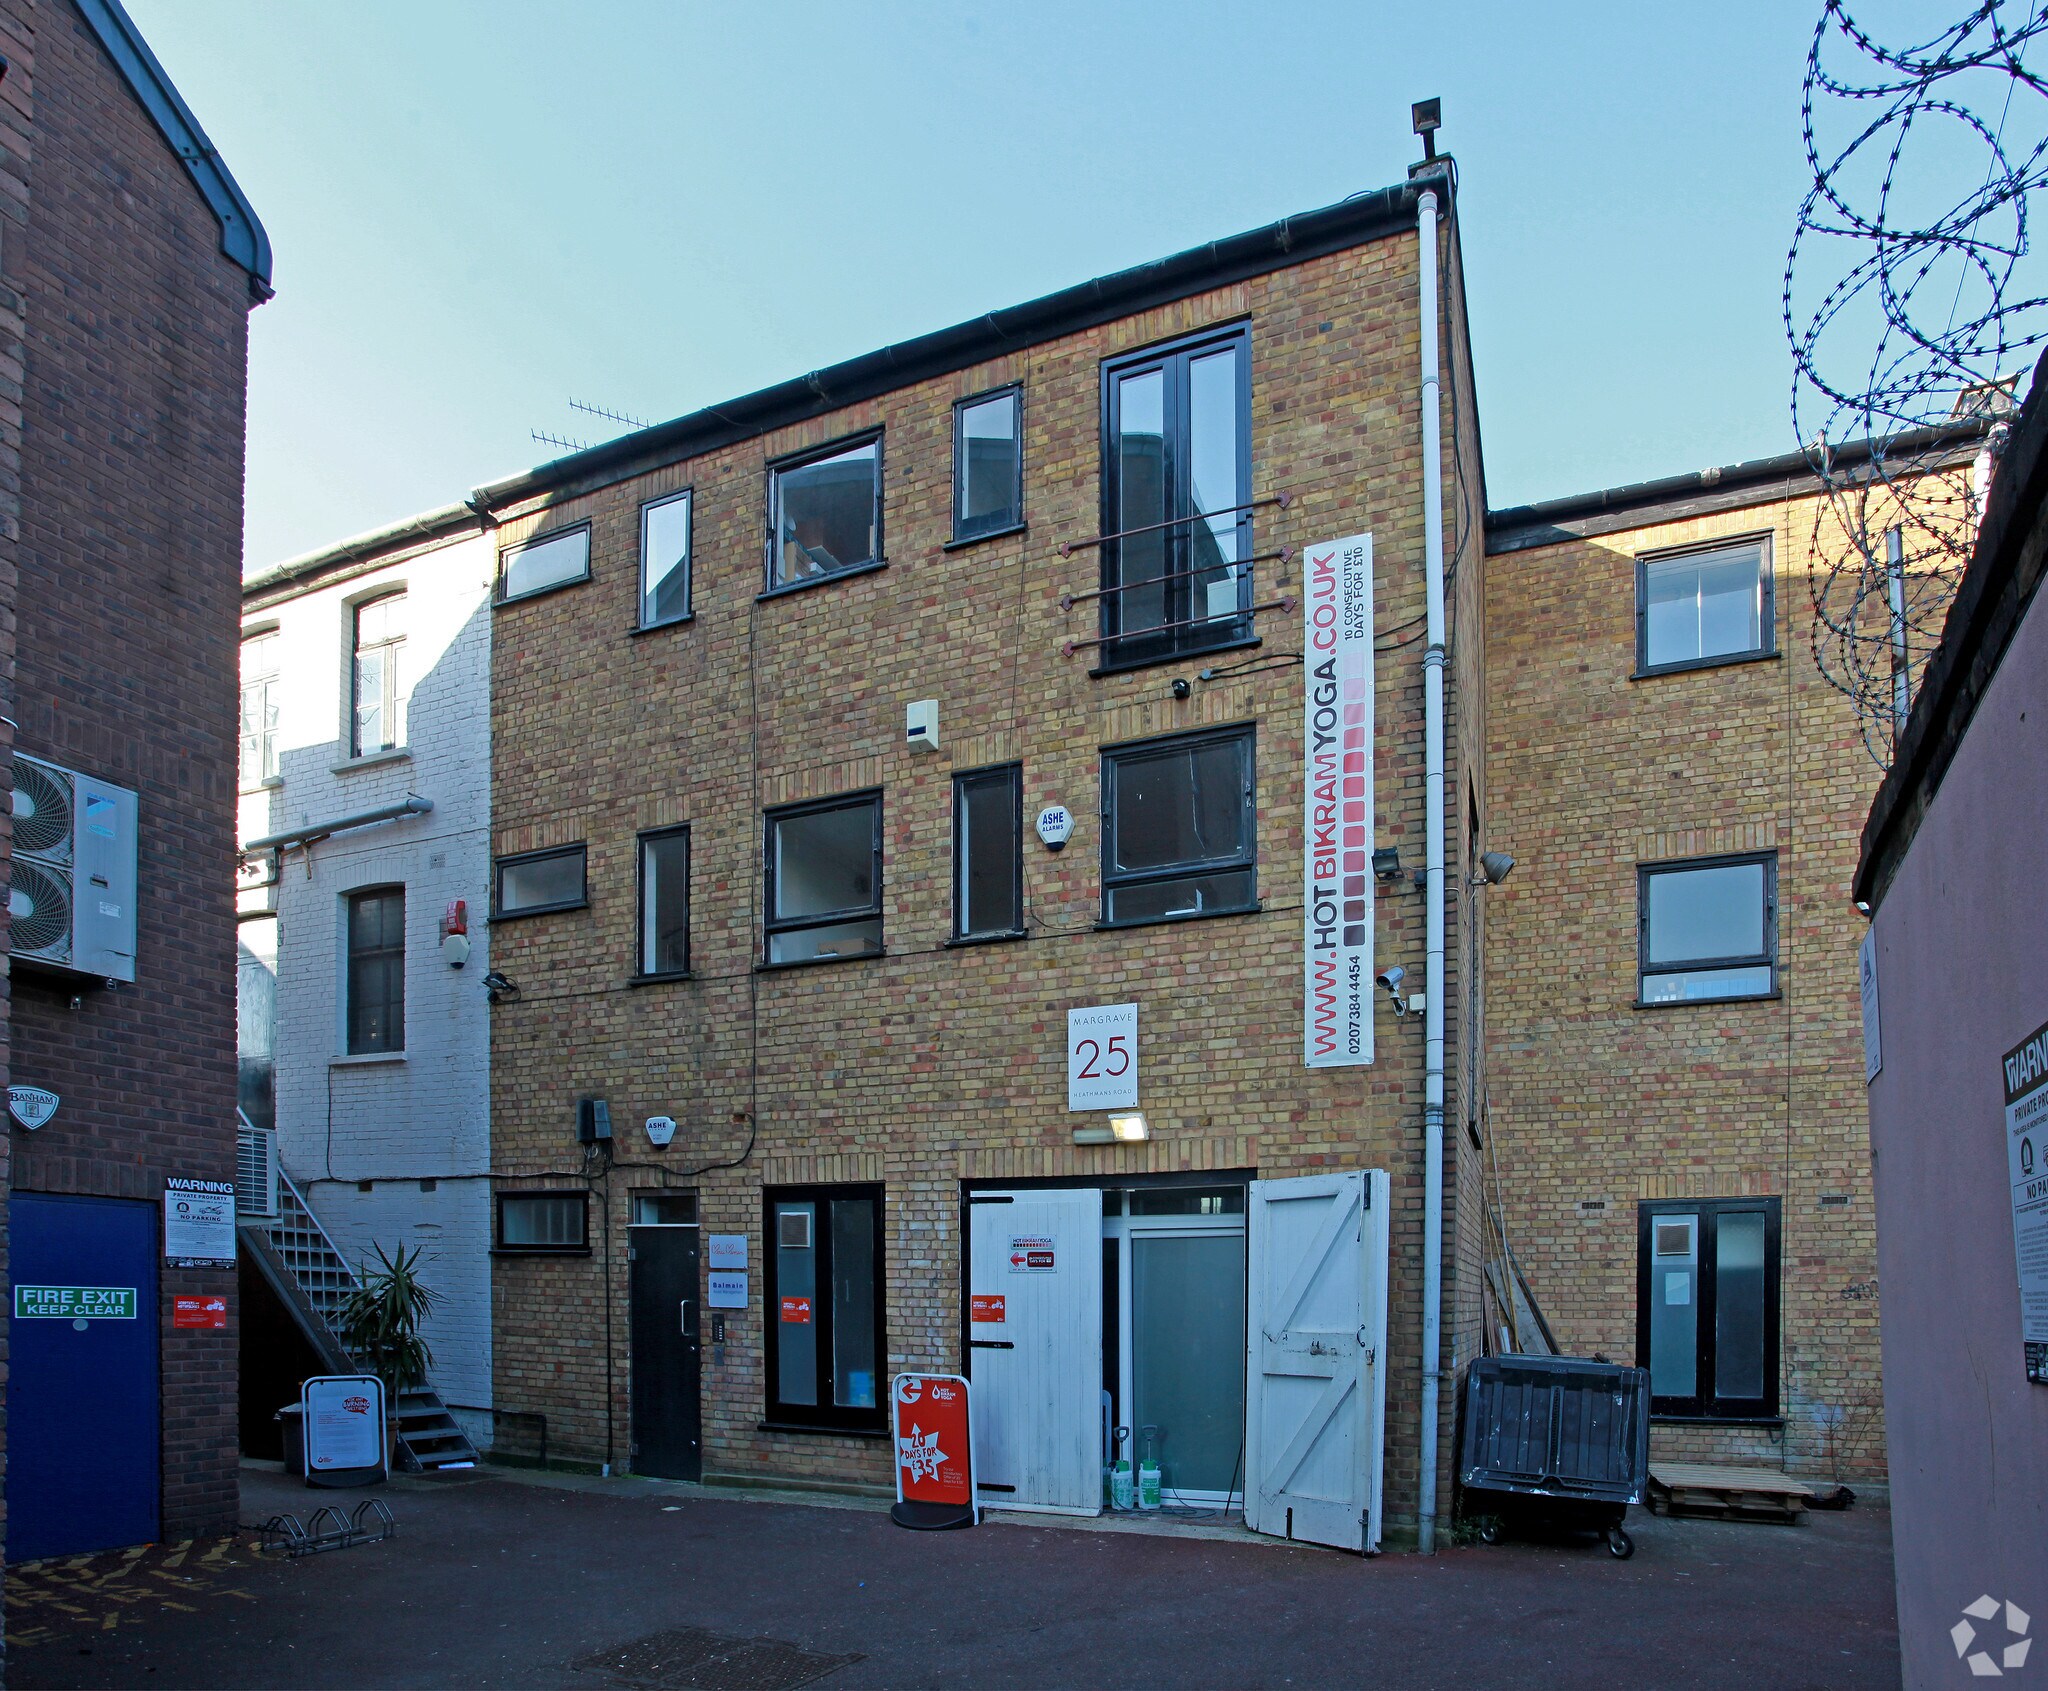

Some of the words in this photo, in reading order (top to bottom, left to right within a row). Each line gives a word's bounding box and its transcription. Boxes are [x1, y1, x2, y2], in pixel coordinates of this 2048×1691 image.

[1353, 546, 1363, 567] £10
[1344, 548, 1353, 626] CONSECUTIVE
[1353, 571, 1364, 599] FOR
[1353, 603, 1364, 639] DAYS
[1344, 629, 1353, 641] 10
[1042, 811, 1064, 825] ASHE
[1042, 824, 1064, 832] ALARMS
[1348, 955, 1360, 991] 4454
[1348, 993, 1360, 1019] 384
[1073, 1013, 1132, 1026] MARGRAVE
[1348, 1021, 1360, 1054] 0207
[1075, 1035, 1129, 1079] 25
[9, 1092, 54, 1105] BANHAM
[1073, 1090, 1112, 1098] HEATHMANS
[2014, 1097, 2037, 1123] PRIVATE
[167, 1177, 233, 1193] WARNING
[2026, 1183, 2037, 1200] NO
[2037, 1178, 2048, 1197] PA
[22, 1289, 75, 1304] FIRE
[81, 1290, 130, 1304] EXIT
[27, 1304, 70, 1315] KEEP
[73, 1305, 125, 1315] CLEAR
[911, 1433, 926, 1449] 20
[904, 1449, 922, 1460] DAYS
[922, 1446, 938, 1458] FOR
[911, 1459, 935, 1478] £35
